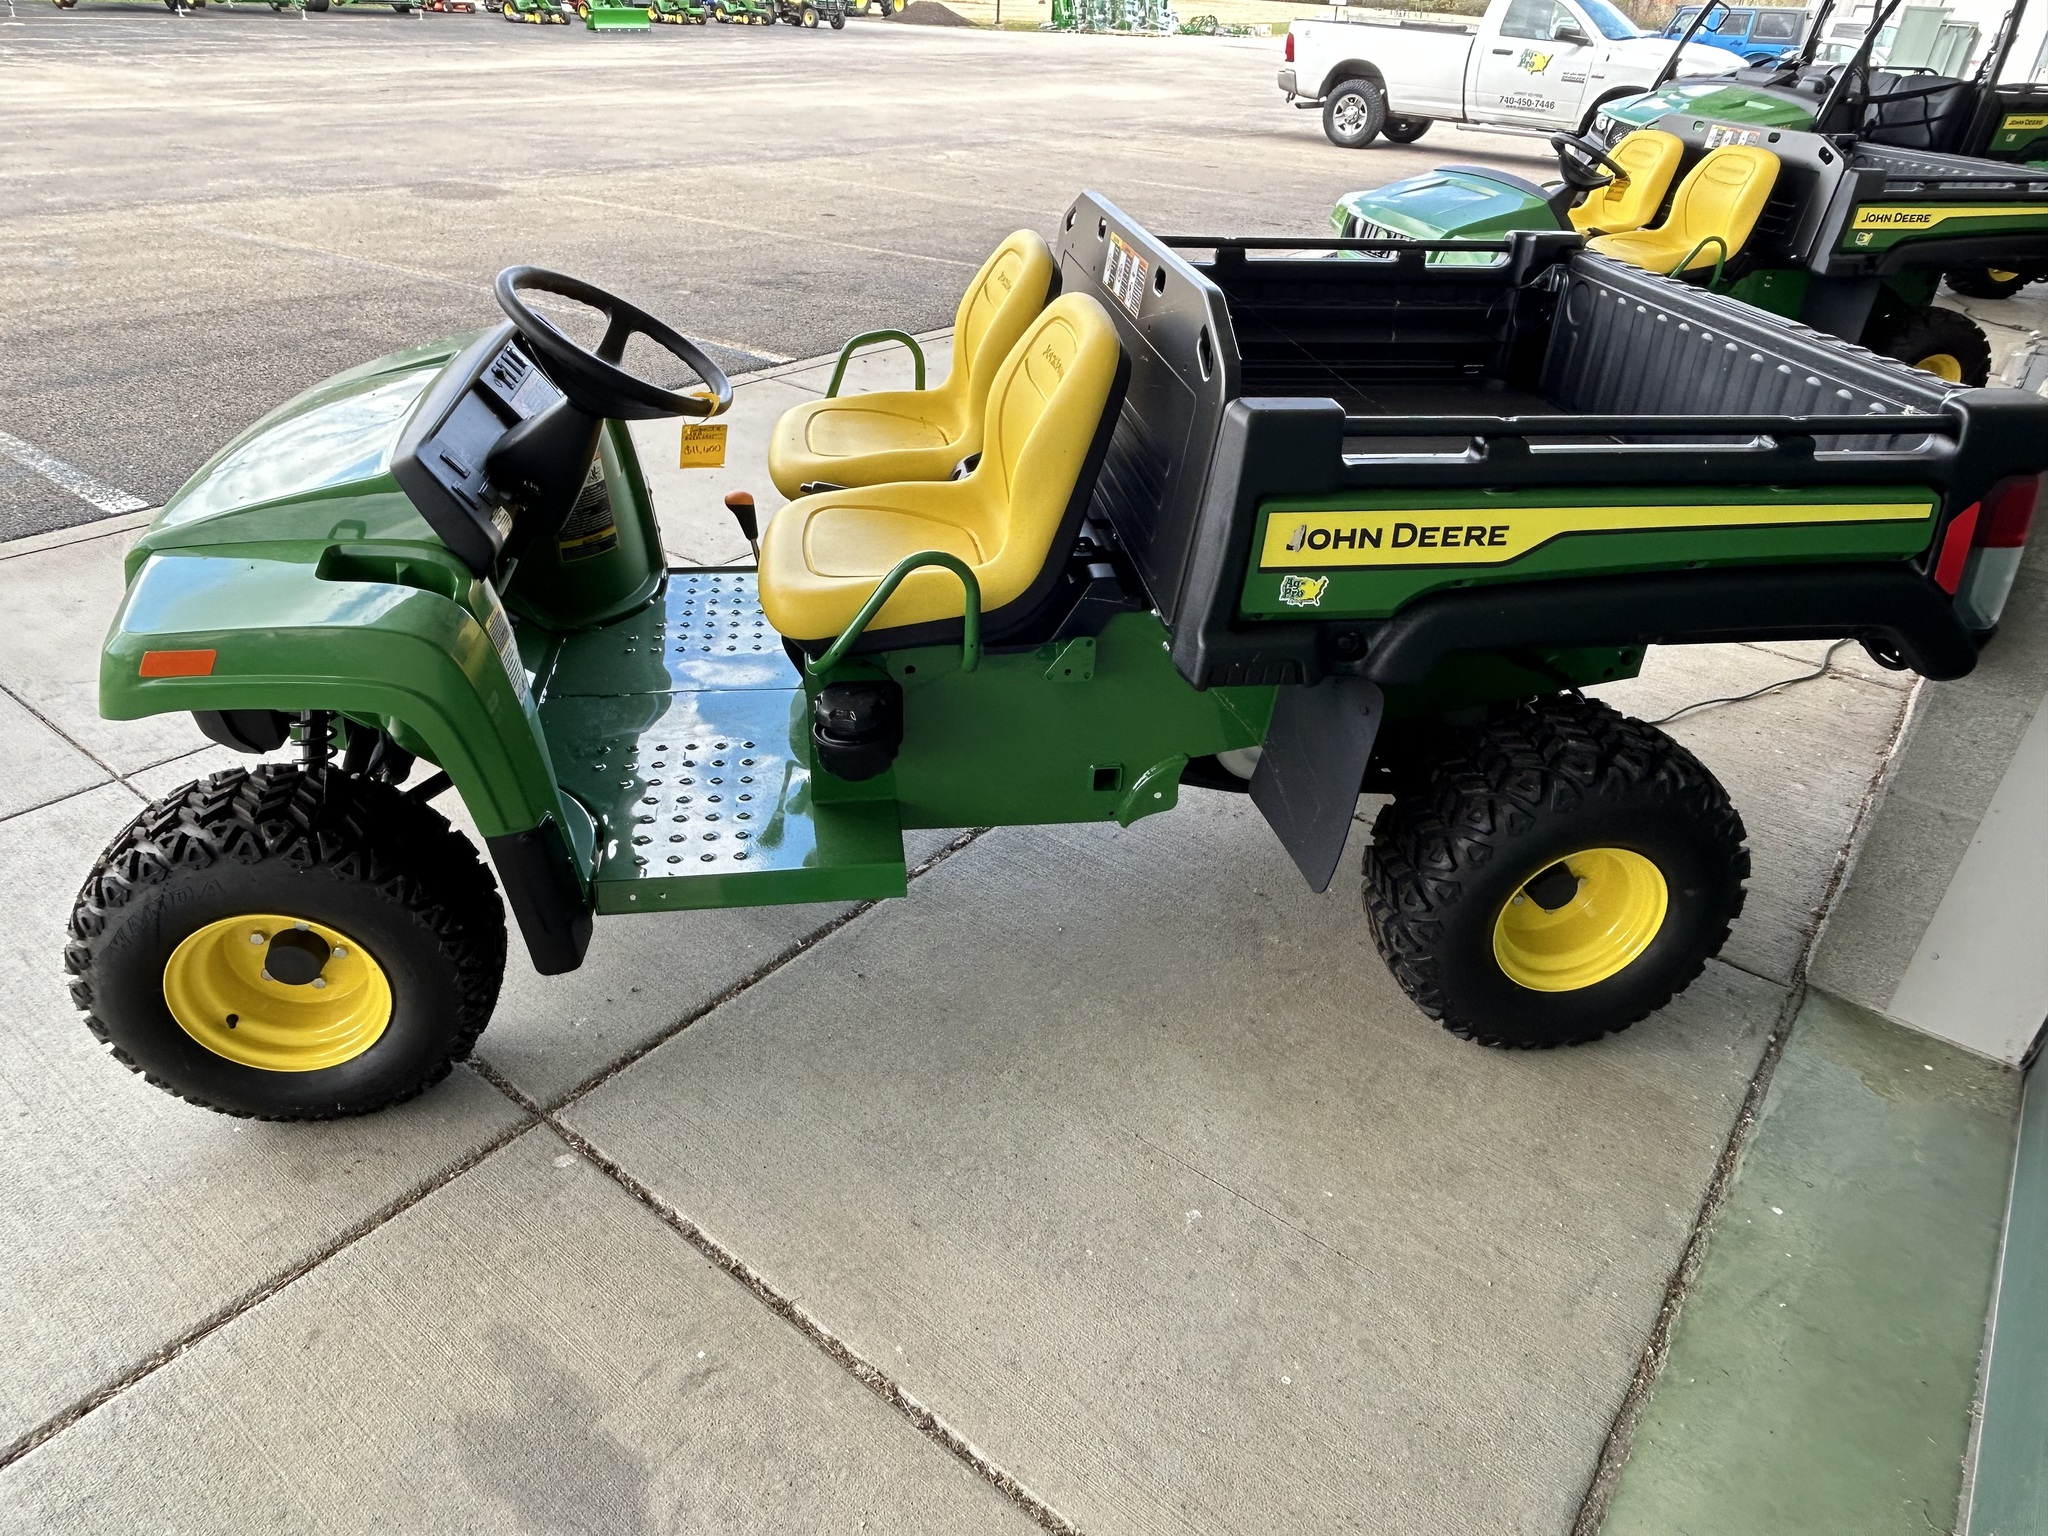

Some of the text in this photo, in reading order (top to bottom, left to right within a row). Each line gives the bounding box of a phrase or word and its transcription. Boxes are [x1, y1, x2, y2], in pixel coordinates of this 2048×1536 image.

[1499, 95, 1555, 110] 740-450-7446
[1861, 212, 1931, 223] JOHN DEERE
[1391, 522, 1510, 548] DEERE
